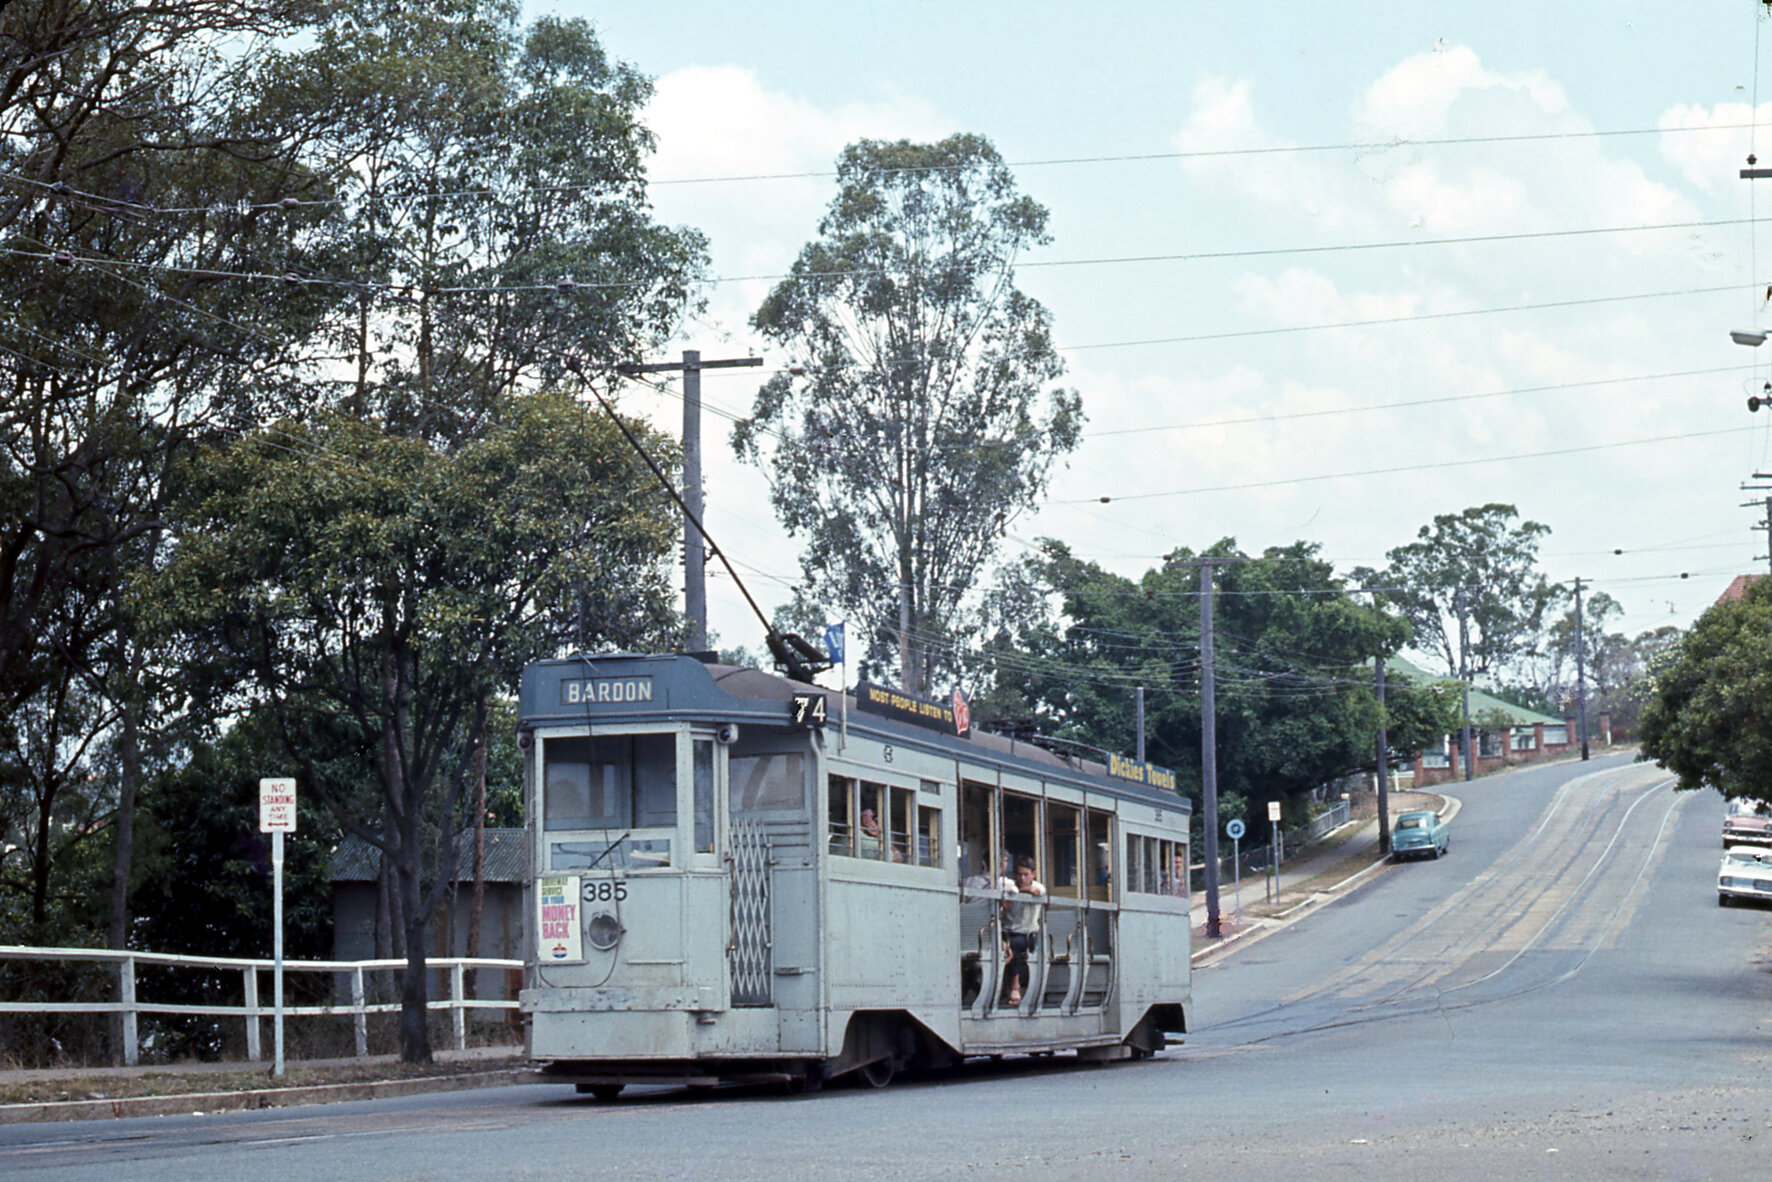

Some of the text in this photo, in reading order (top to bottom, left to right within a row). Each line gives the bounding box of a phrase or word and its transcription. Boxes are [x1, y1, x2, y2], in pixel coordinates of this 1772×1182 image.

[568, 681, 653, 703] BARDON
[794, 696, 826, 723] 74
[869, 687, 889, 704] MOST
[891, 693, 917, 713] PEOPLE
[919, 702, 941, 719] LISTEN
[943, 708, 952, 723] TO
[1109, 753, 1175, 790] Dickies Towels
[271, 783, 285, 793] NO
[262, 794, 294, 805] STANDING
[583, 881, 628, 903] 385
[541, 904, 577, 922] MONEY
[541, 921, 570, 940] BACK
